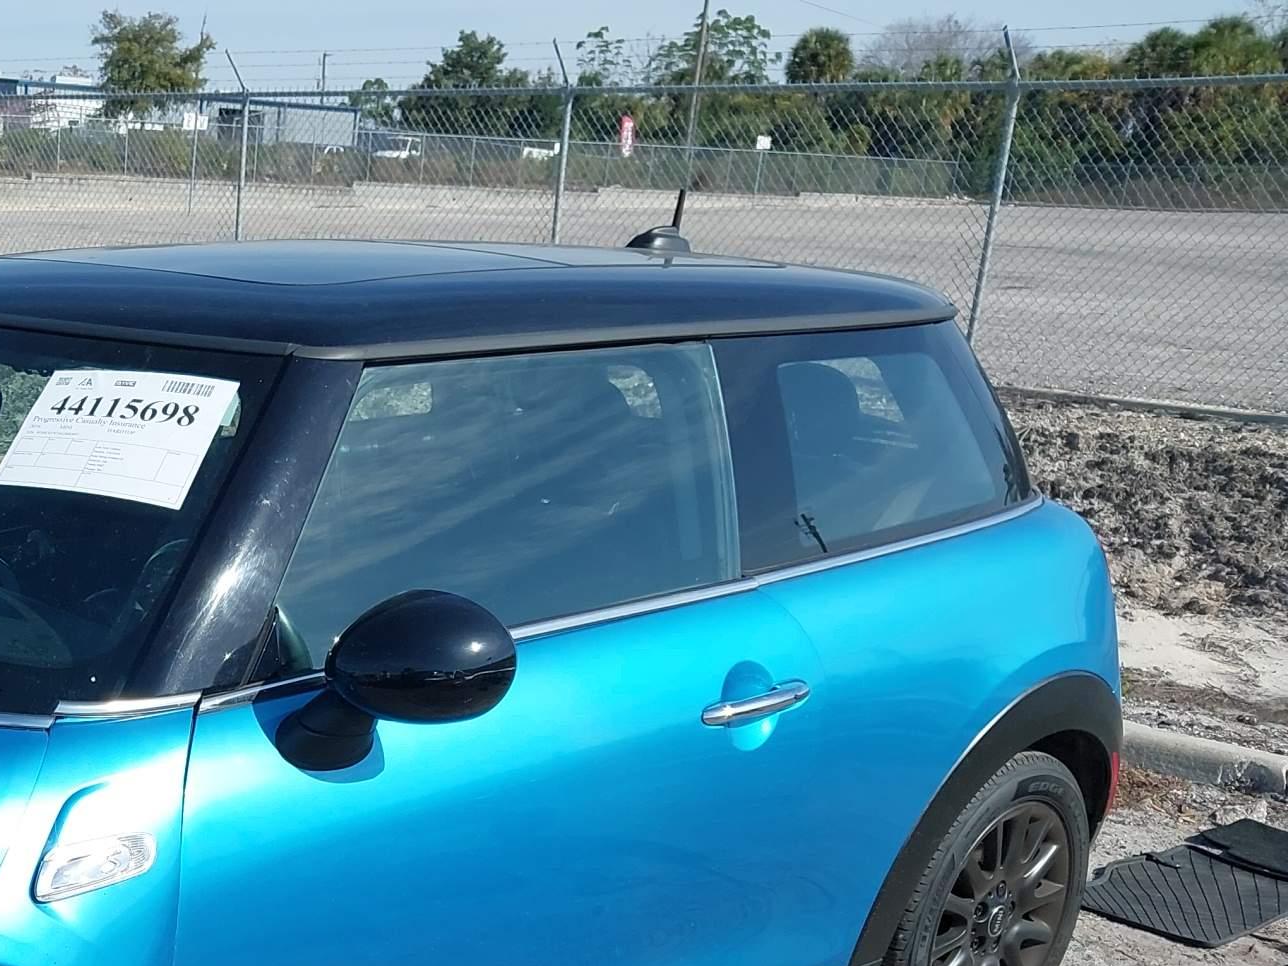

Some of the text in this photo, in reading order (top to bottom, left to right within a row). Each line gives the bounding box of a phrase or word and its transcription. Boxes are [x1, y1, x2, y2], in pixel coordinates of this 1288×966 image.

[32, 415, 147, 430] Progressive Casualty Insurance
[50, 395, 200, 427] 44115698
